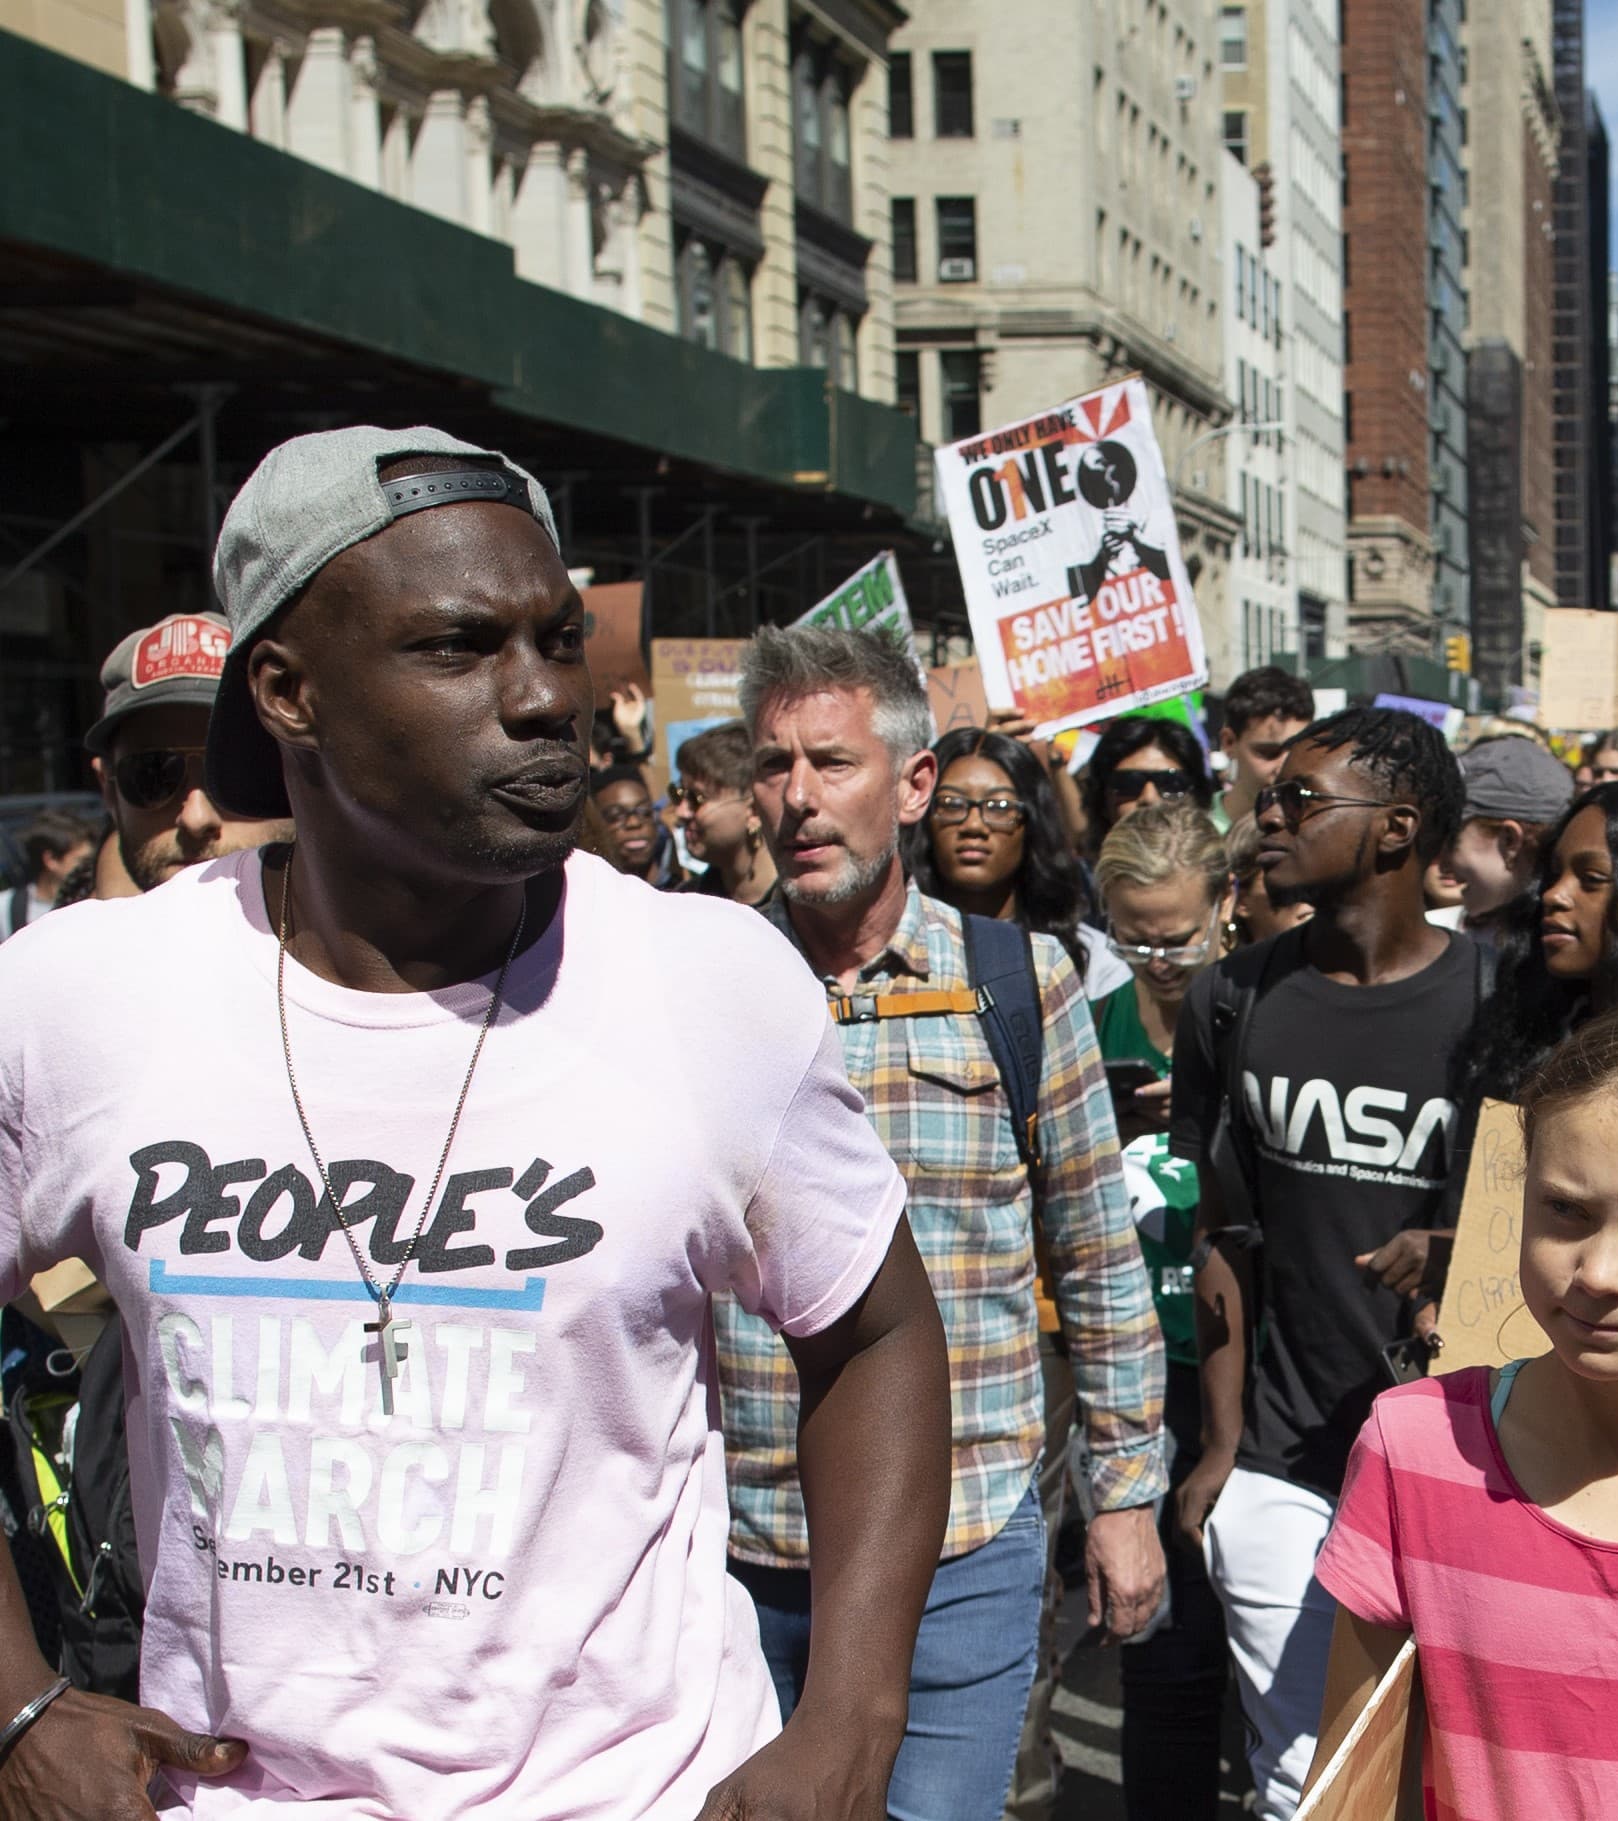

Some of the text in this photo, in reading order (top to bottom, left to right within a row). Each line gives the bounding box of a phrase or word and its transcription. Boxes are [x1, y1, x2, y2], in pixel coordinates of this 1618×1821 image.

[960, 409, 1077, 465] WE ONLY HAVE
[982, 518, 1053, 555] SpaceX
[988, 556, 1025, 577] Can
[1012, 572, 1166, 650] SAVE OUR
[1007, 633, 1094, 691] HOME
[1242, 1070, 1459, 1170] NASA
[1325, 1163, 1349, 1177] and
[1349, 1165, 1385, 1183] Space
[124, 1140, 604, 1274] PEOPLE'S
[158, 1311, 538, 1434] CLIMATE
[192, 1525, 506, 1600] Seember 21st NYC
